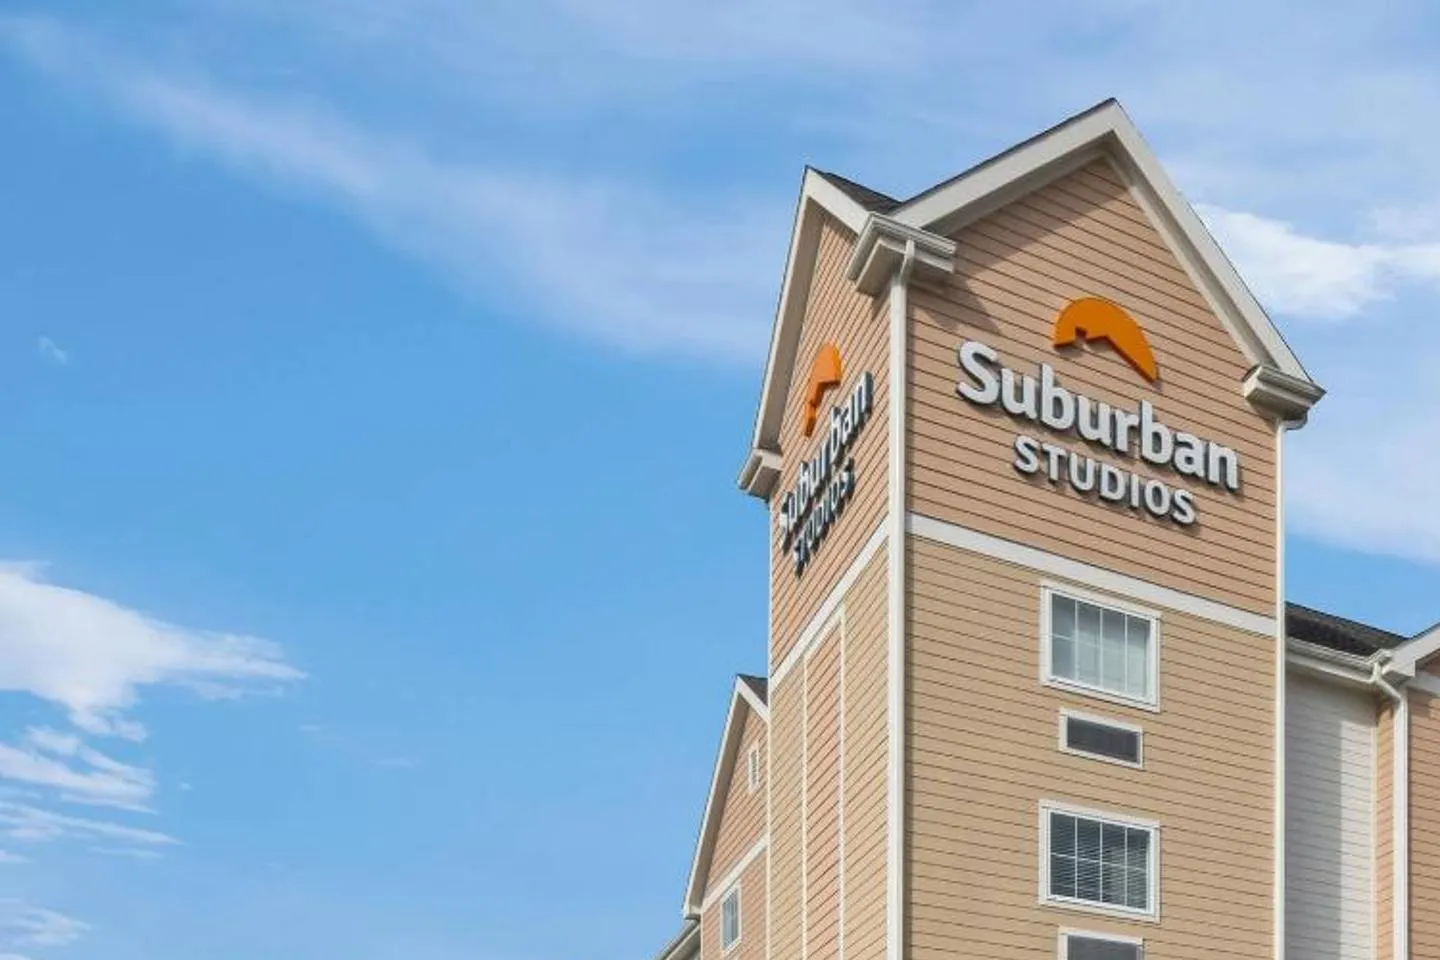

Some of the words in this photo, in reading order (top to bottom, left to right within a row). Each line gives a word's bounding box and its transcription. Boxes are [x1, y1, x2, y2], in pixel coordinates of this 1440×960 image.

[780, 371, 872, 551] Suburban
[957, 341, 1239, 490] Suburban
[1014, 435, 1196, 525] STUDIOS
